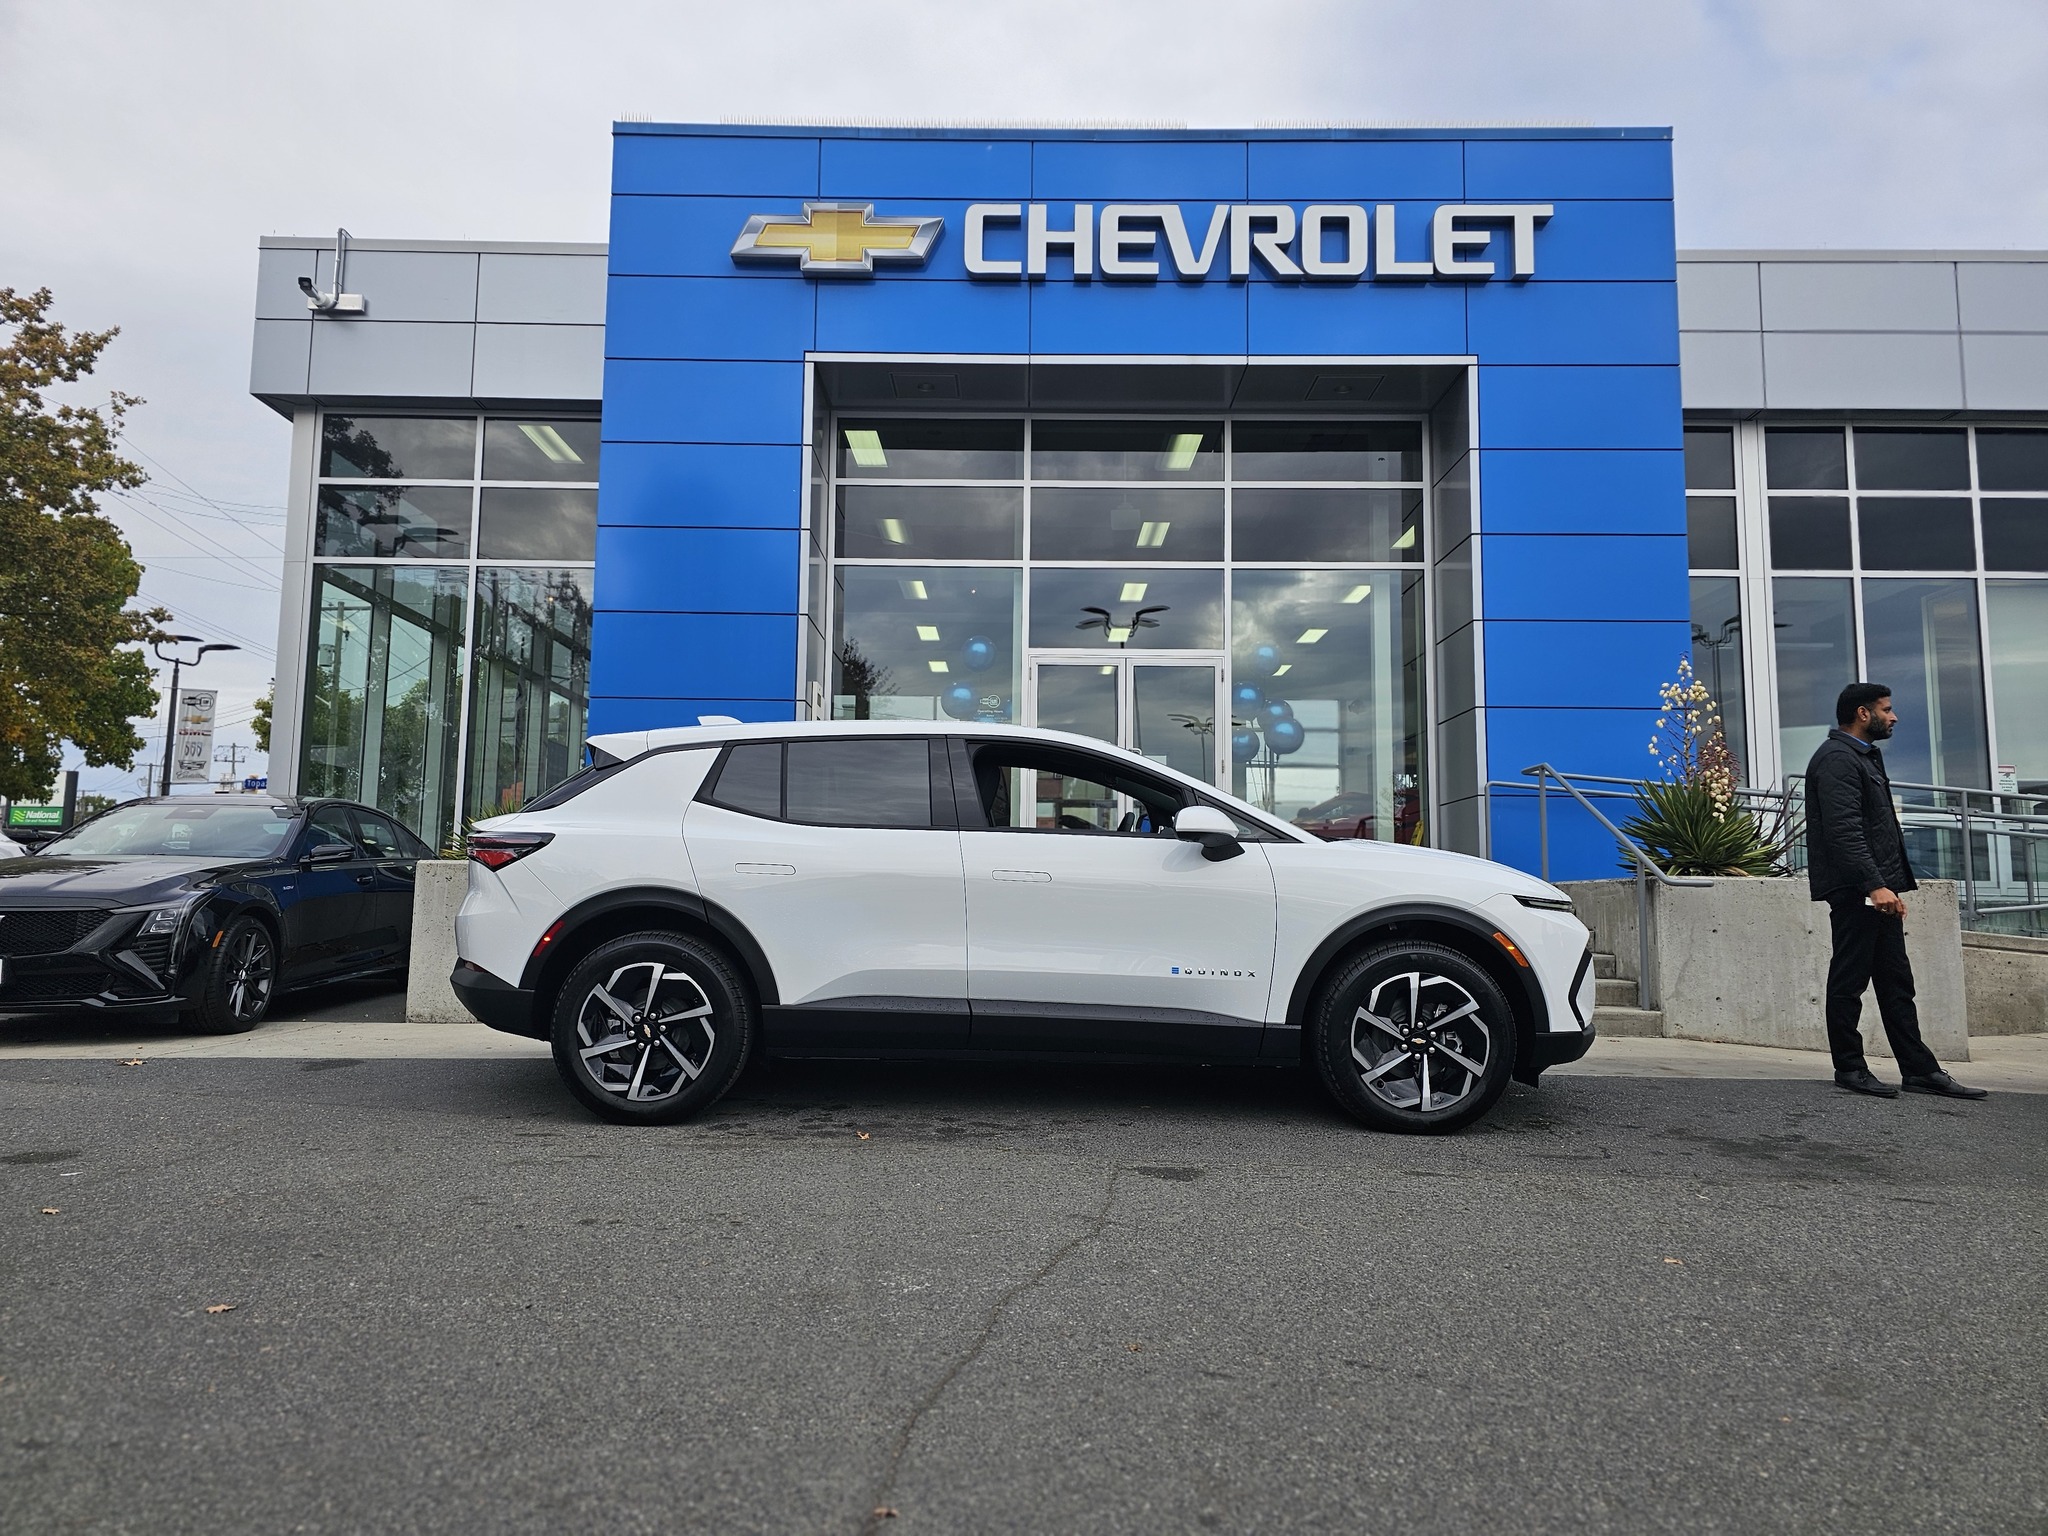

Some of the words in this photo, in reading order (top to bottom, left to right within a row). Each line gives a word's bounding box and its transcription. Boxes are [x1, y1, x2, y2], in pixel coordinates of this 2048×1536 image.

[964, 203, 1554, 279] CHEVROLET
[179, 728, 212, 736] GMC
[1171, 966, 1256, 978] EQUINOX
